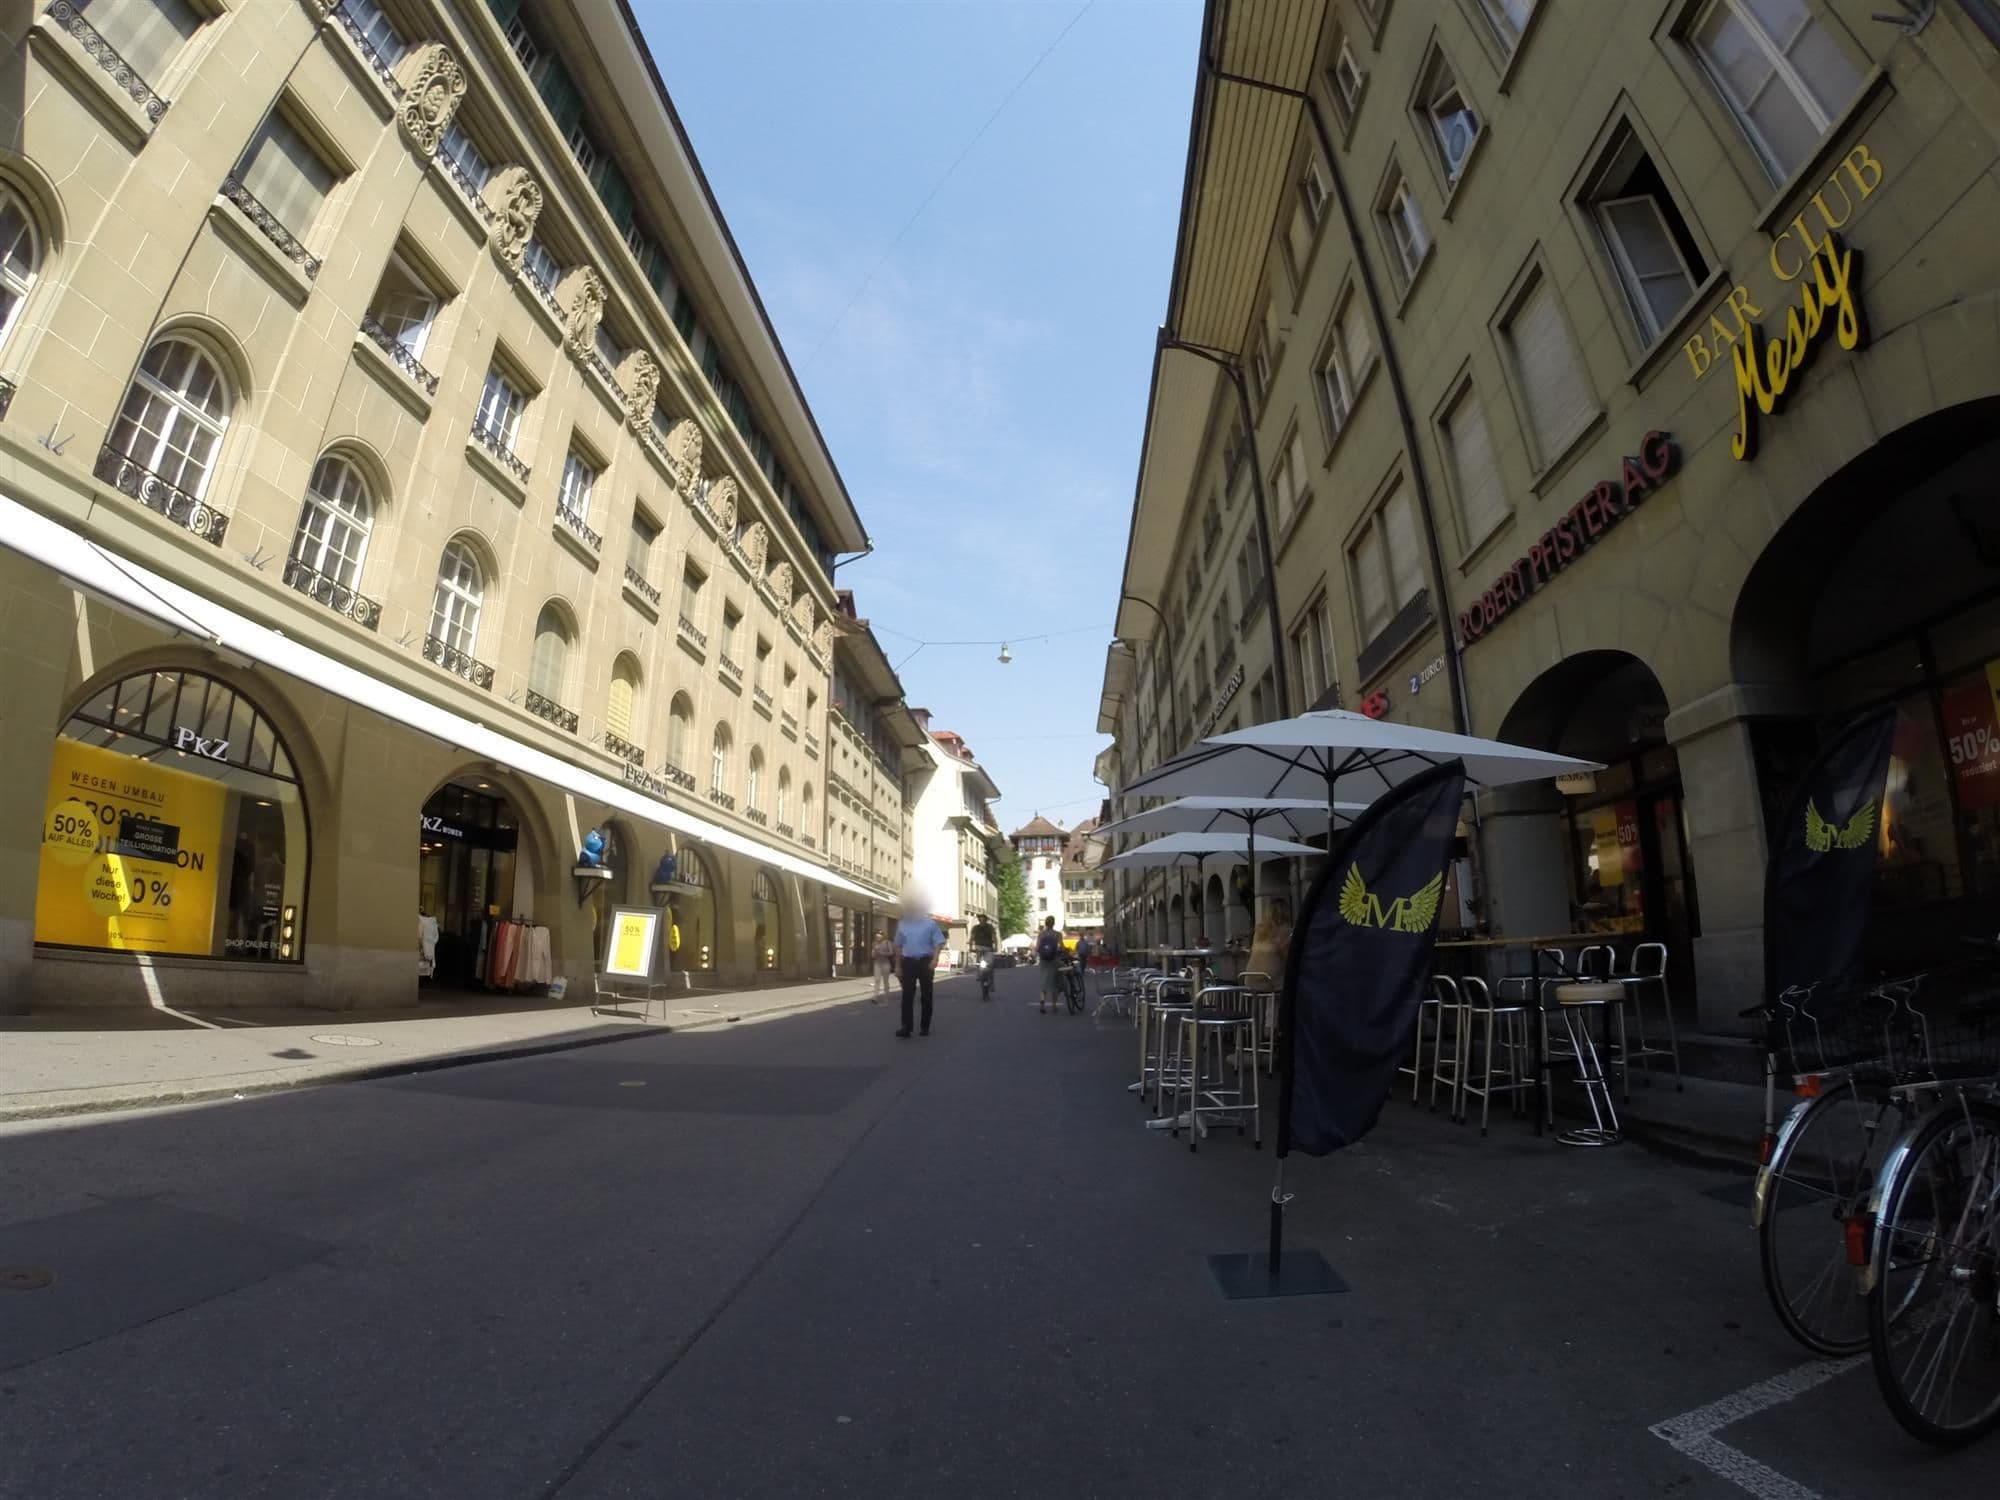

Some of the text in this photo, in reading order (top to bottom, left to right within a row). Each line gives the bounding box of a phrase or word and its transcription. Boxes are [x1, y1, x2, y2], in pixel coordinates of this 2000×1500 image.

[1683, 143, 1883, 380] BAR CLUB
[1731, 230, 1859, 461] Messy
[1458, 430, 1672, 642] ROBERT PFISTER AG
[174, 726, 230, 762] PKZ
[1949, 725, 2000, 764] 50%
[71, 771, 165, 802] WEGEN UMBAU
[48, 832, 65, 842] AUF
[54, 813, 93, 838] 50%
[134, 831, 163, 844] GROSSE
[120, 838, 177, 855] TEILLIQUIDATION
[102, 863, 118, 874] Nur
[95, 877, 121, 888] diese
[132, 878, 171, 906] 0%
[91, 889, 126, 903] Woche!
